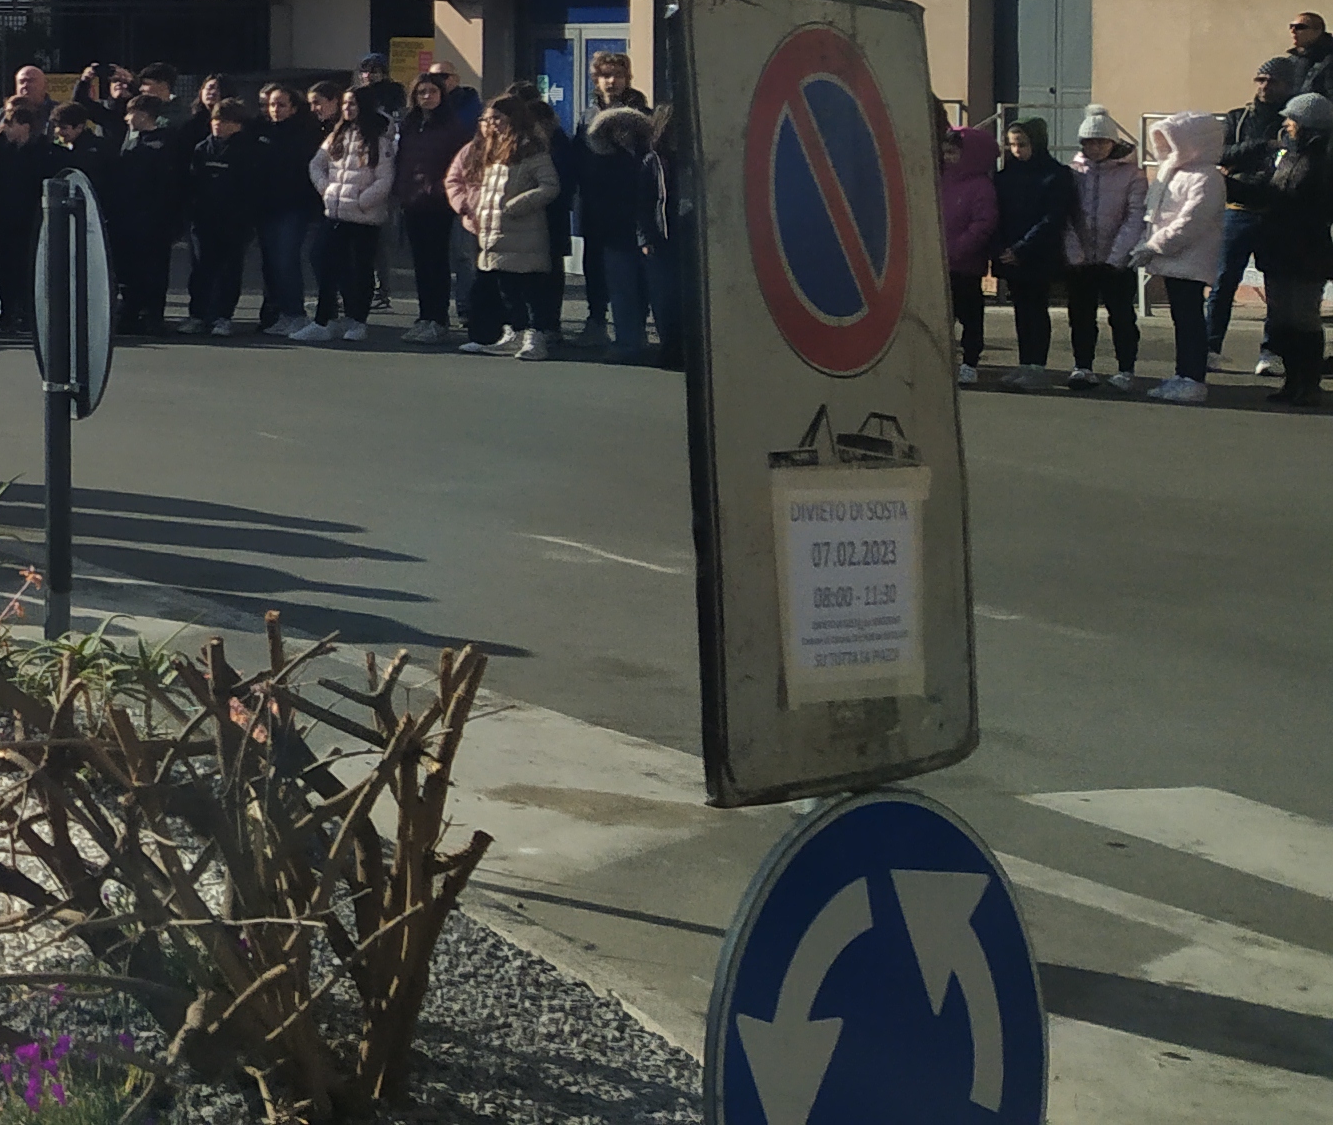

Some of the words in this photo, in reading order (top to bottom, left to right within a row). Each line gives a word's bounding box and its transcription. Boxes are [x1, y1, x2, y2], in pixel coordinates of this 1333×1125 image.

[790, 500, 845, 522] DIVIETO
[850, 500, 863, 521] DI
[867, 500, 909, 521] SOSTA
[812, 539, 897, 568] 07.02.2023
[813, 586, 853, 608] 08:00
[864, 584, 897, 606] 11:30
